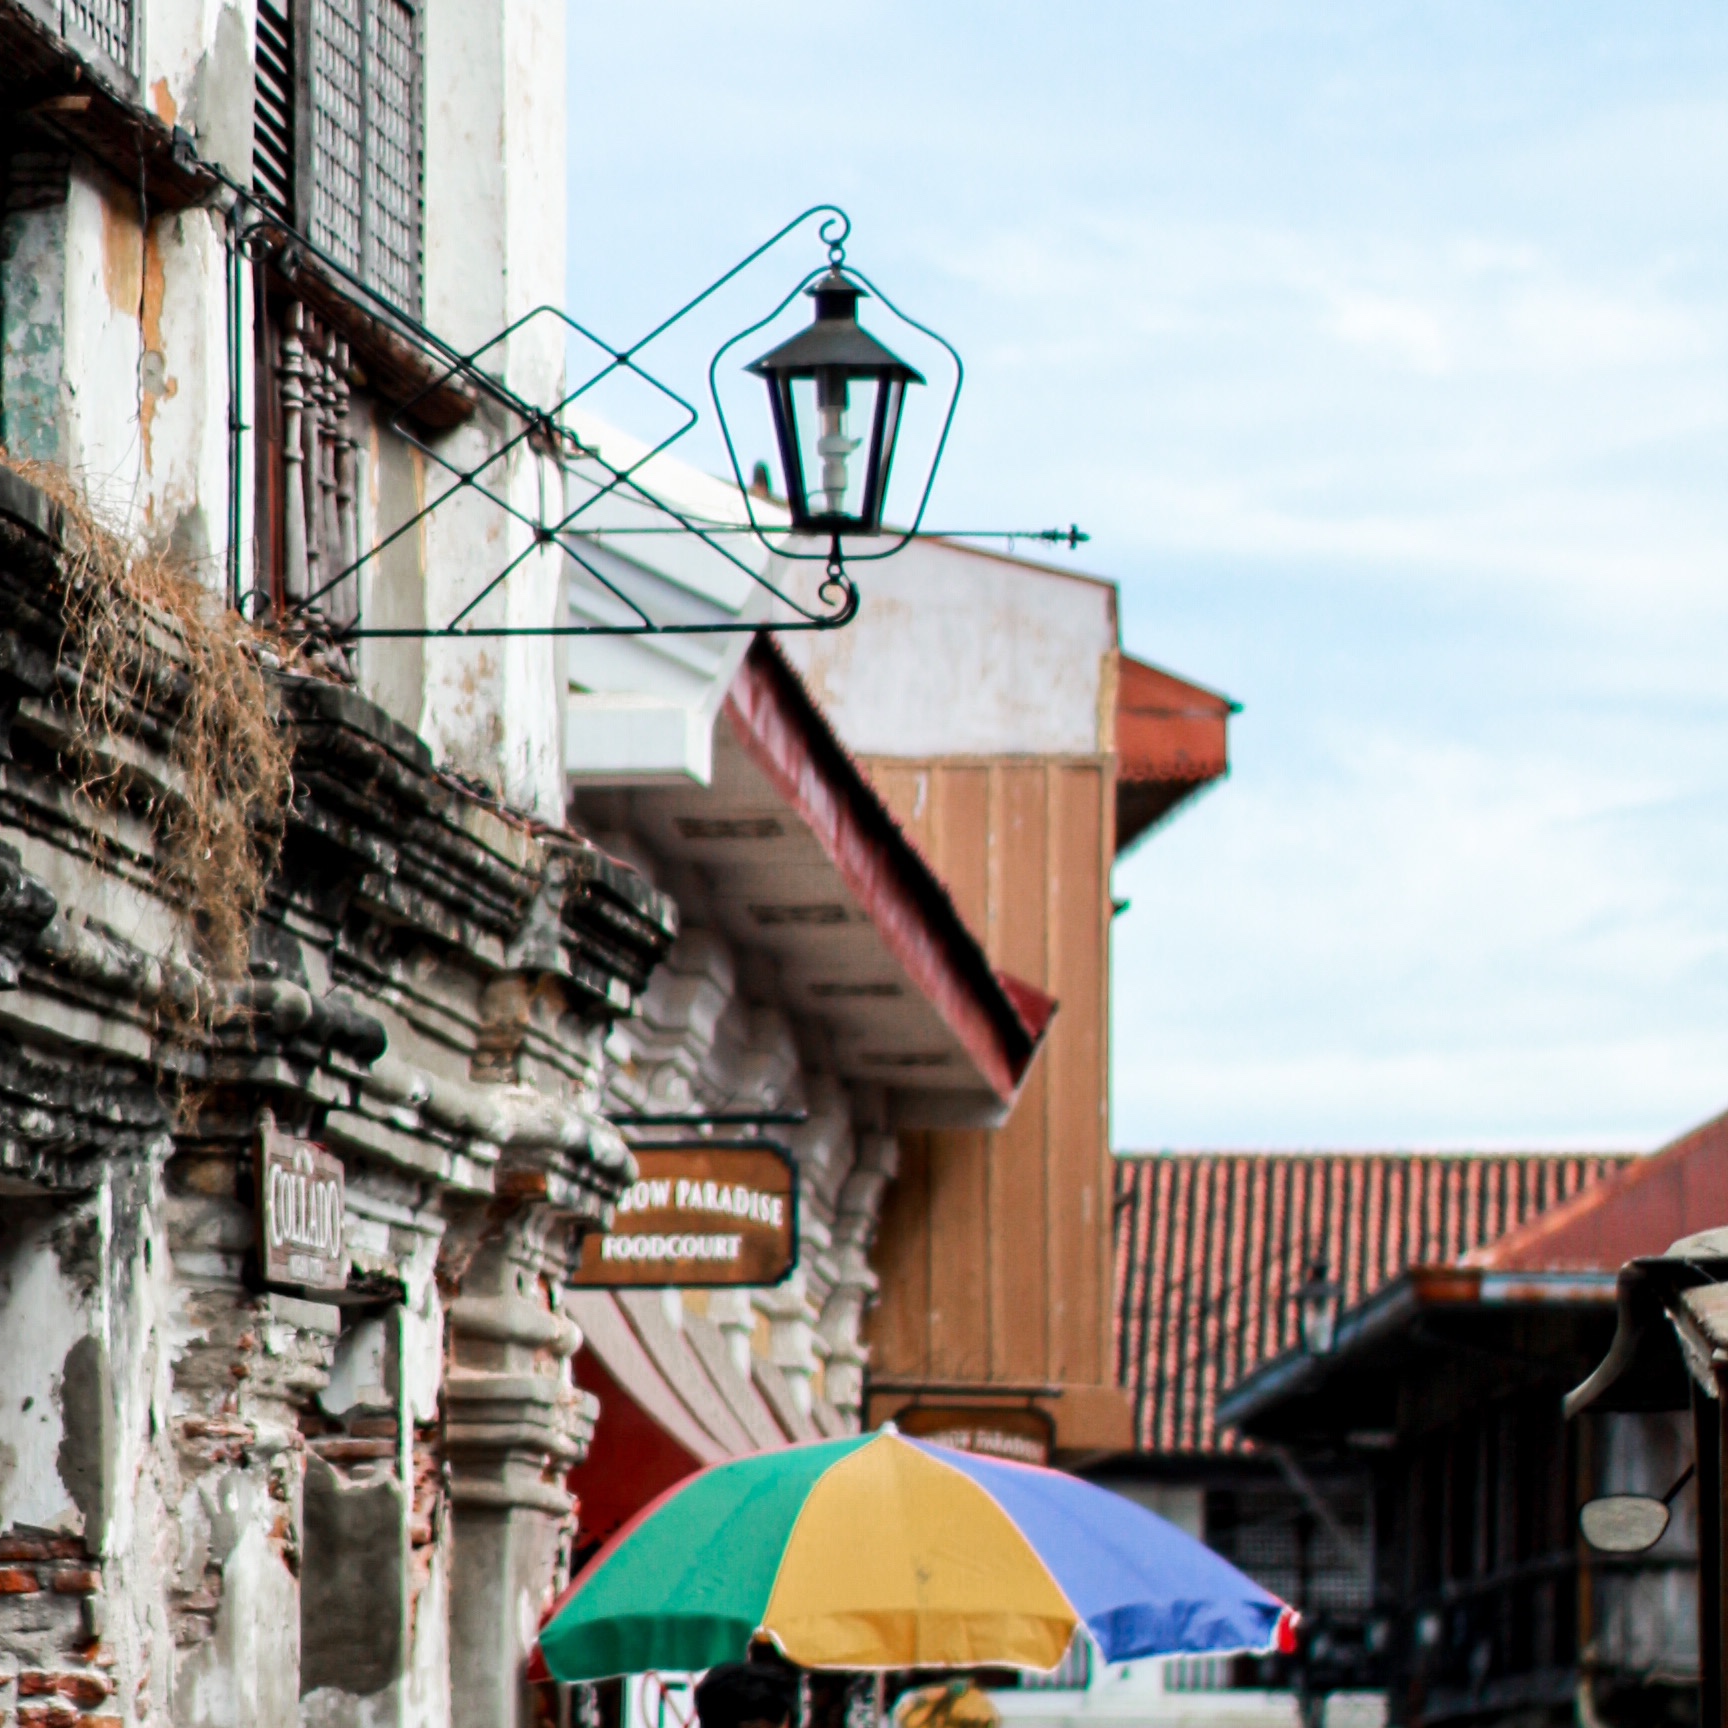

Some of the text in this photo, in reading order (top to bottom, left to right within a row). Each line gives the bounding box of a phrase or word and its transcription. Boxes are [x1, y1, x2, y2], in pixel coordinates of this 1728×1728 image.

[269, 1163, 340, 1259] COLLADO
[675, 1178, 784, 1229] PARADISE
[601, 1233, 743, 1262] FOODCOURT
